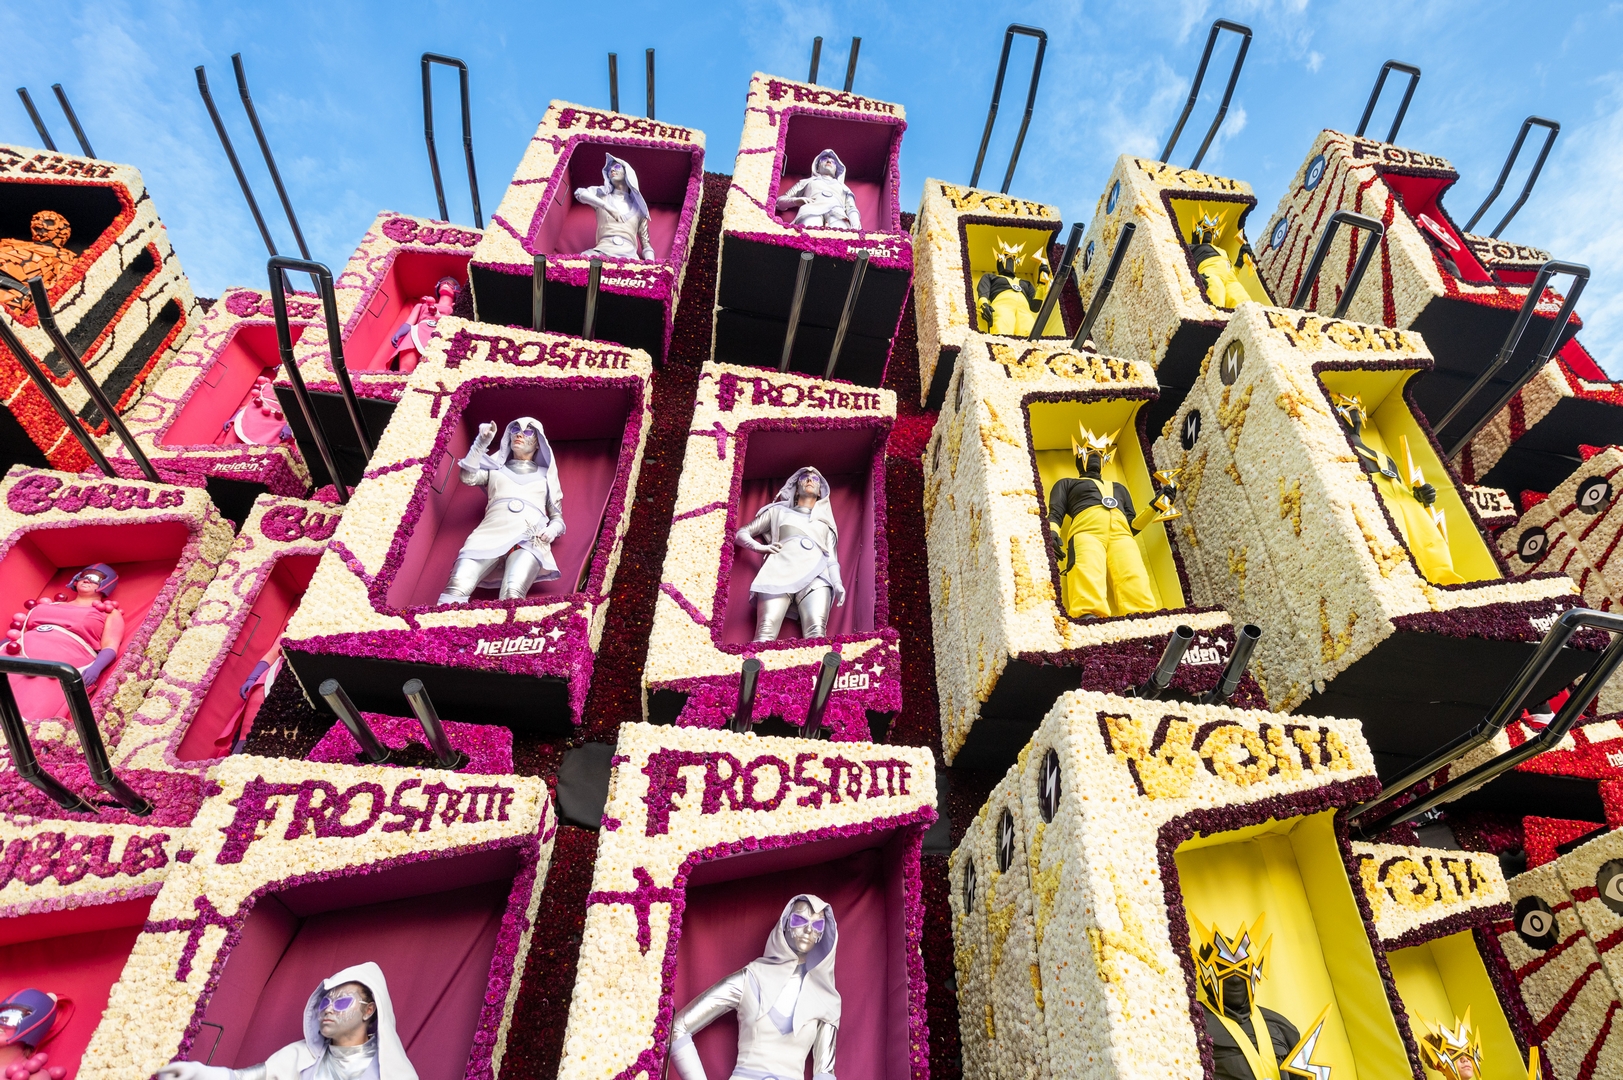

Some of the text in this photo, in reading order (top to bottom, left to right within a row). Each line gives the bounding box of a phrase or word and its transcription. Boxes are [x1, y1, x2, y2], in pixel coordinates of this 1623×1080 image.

[764, 79, 895, 114] FROSTBITE
[558, 108, 692, 141] FROSTBITE
[1352, 141, 1446, 167] FOCUS
[1467, 240, 1549, 261] FOCUS
[600, 275, 646, 289] helden
[442, 327, 632, 370] FROSTBITE
[715, 372, 881, 412] FROSTBITE
[213, 462, 260, 472] helden
[473, 635, 546, 656] helden
[1096, 712, 1356, 800] VOLTA
[640, 747, 913, 837] FROSTBITE
[216, 775, 515, 864] FROSTBITE
